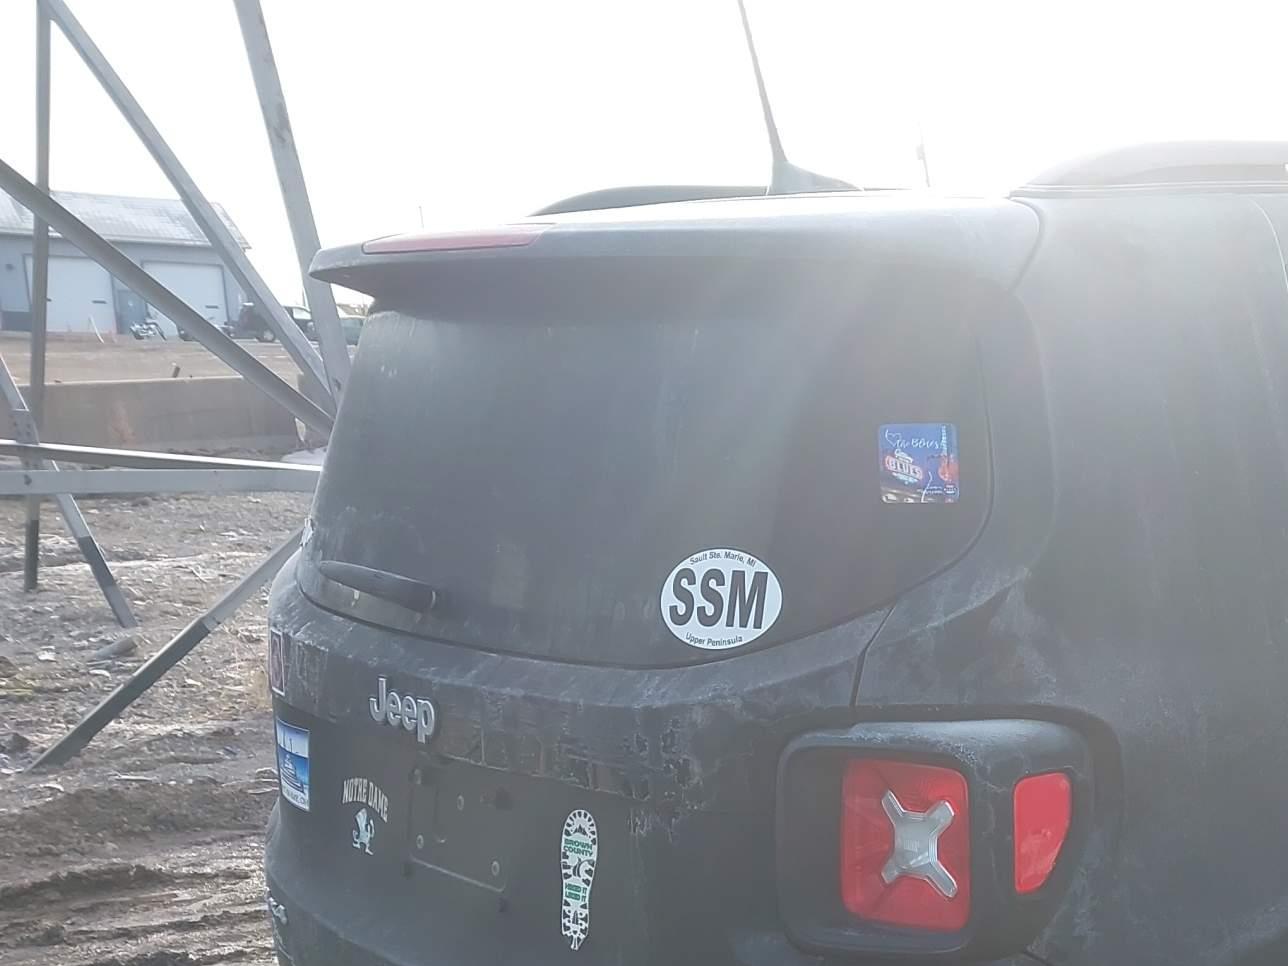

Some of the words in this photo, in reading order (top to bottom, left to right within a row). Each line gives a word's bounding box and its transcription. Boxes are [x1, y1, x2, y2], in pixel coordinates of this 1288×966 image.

[690, 553, 708, 565] Sault
[709, 551, 722, 560] Ste.
[723, 551, 745, 564] Marie,
[746, 558, 757, 568] MI
[669, 567, 769, 630] SSM
[685, 632, 706, 645] Upper
[707, 635, 743, 647] Peninsula
[369, 676, 436, 744] Jeep
[342, 777, 368, 804] NOTRE
[368, 781, 389, 823] DAME
[563, 845, 594, 857] COUNTY
[564, 838, 593, 851] BROWN
